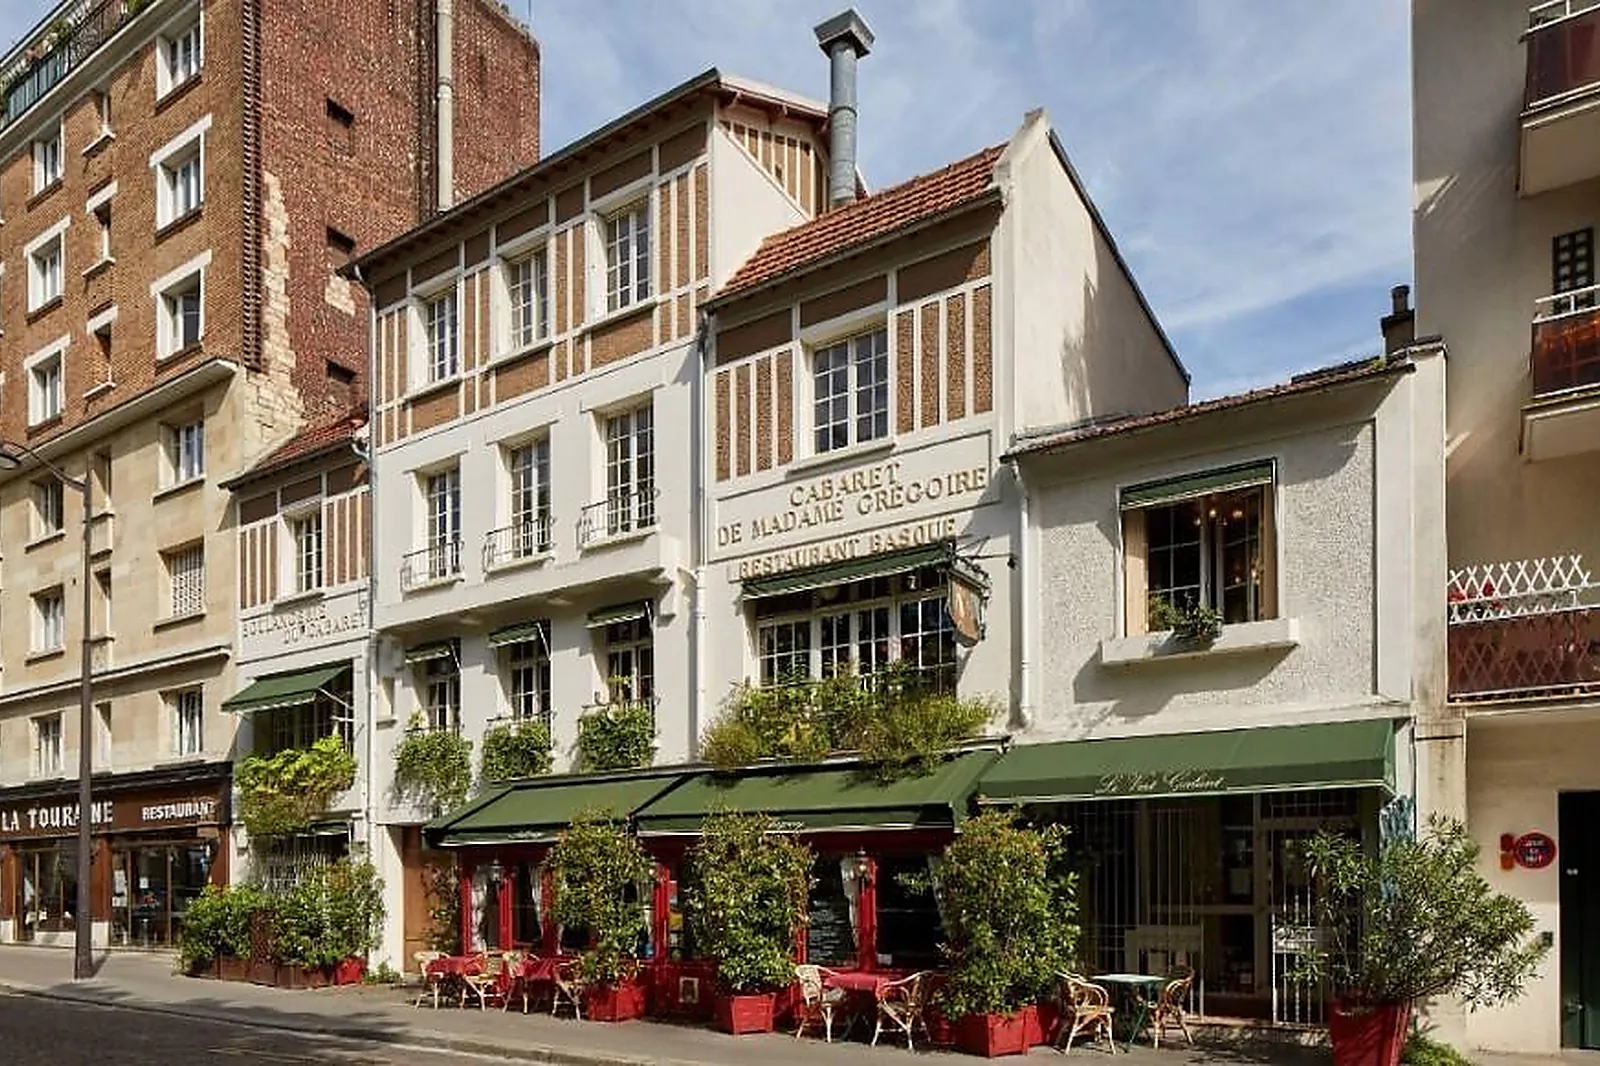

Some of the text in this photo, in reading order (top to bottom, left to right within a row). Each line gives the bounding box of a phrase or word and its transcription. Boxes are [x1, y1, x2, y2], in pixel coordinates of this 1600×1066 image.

[789, 462, 901, 507] CABARET
[717, 522, 743, 547] DE
[751, 499, 844, 541] MADAME
[738, 517, 956, 580] RESTAURANT BASQUE
[1, 801, 216, 832] LA TOURANE RESTAURANT
